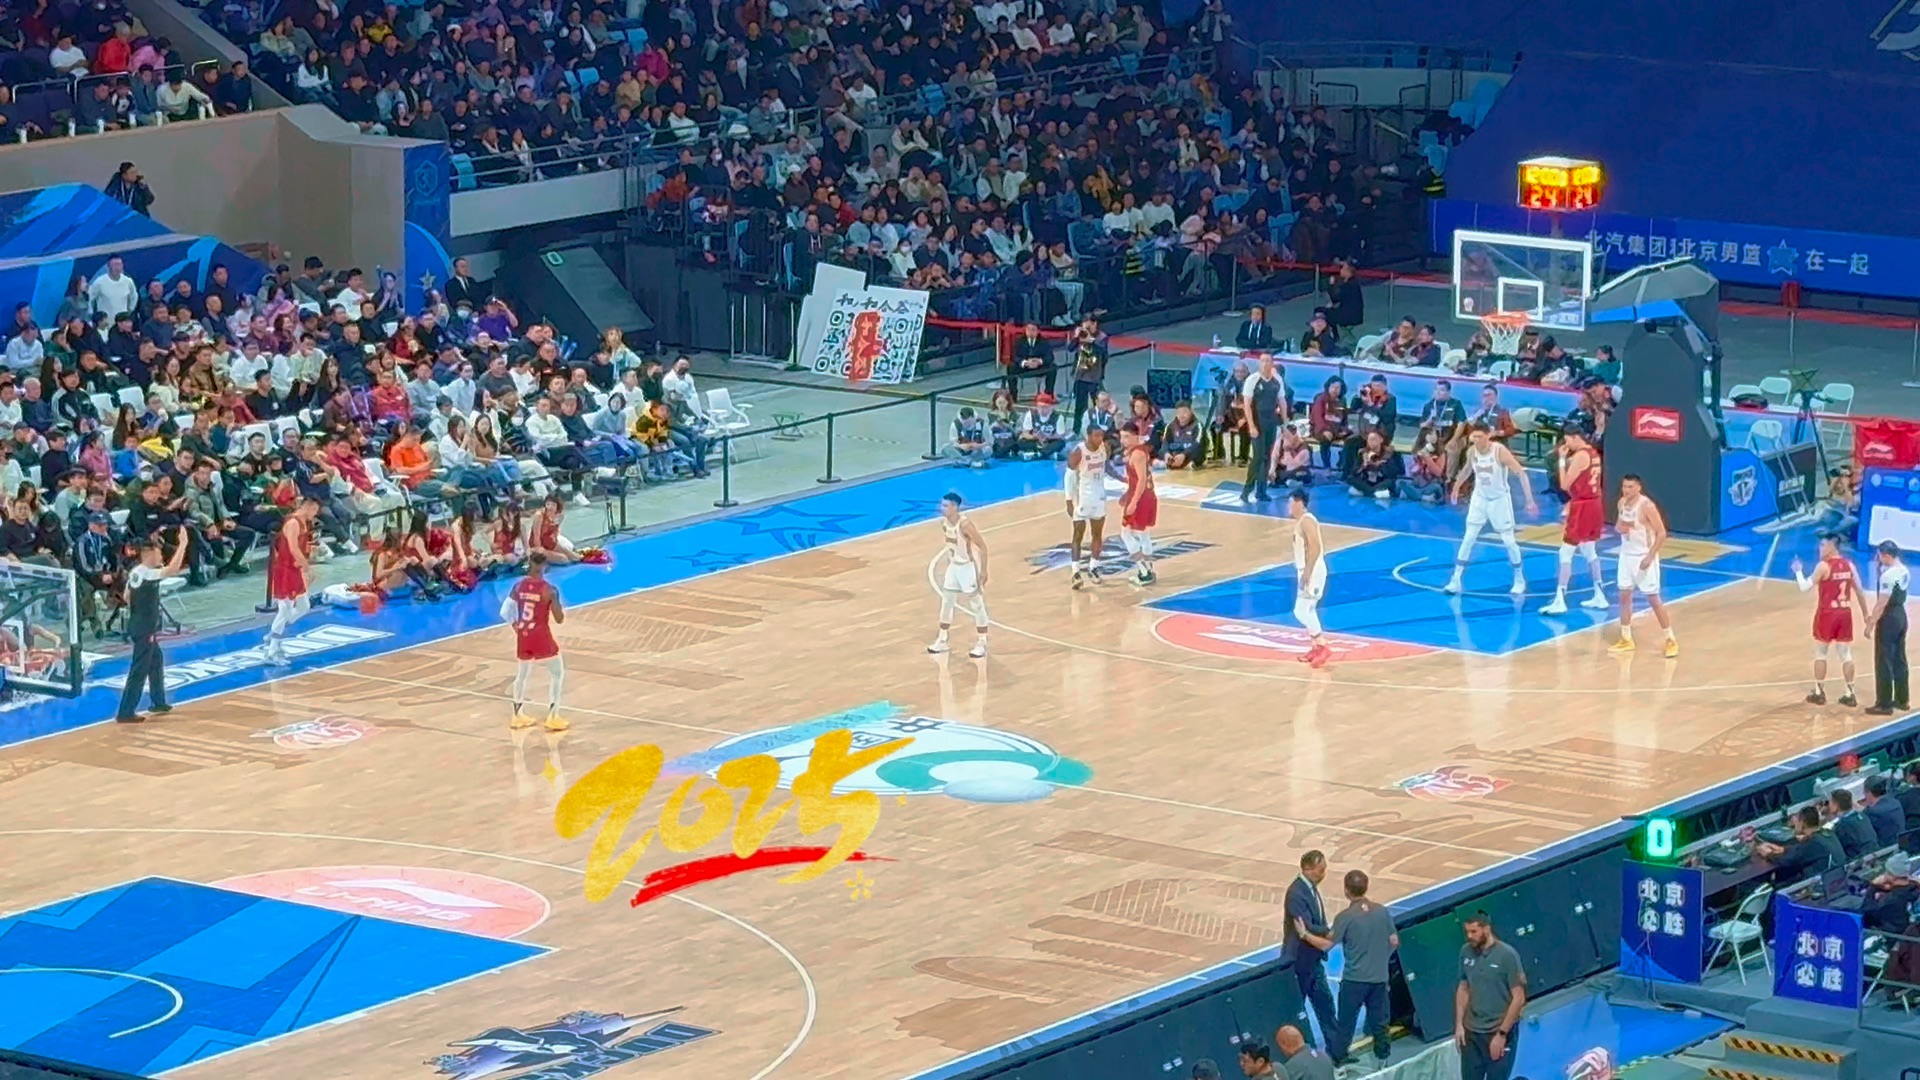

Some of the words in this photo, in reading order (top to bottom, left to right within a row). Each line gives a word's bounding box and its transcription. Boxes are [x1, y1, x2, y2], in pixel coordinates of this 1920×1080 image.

[1530, 184, 1557, 208] 24
[1805, 249, 1870, 275] 在一起
[522, 602, 536, 621] 5
[1647, 818, 1673, 857] 0
[295, 886, 473, 921] LI-NING
[1638, 877, 1685, 906] 北京
[1638, 909, 1686, 937] 必胜
[1796, 931, 1843, 960] 北京
[1795, 962, 1843, 992] 必胜
